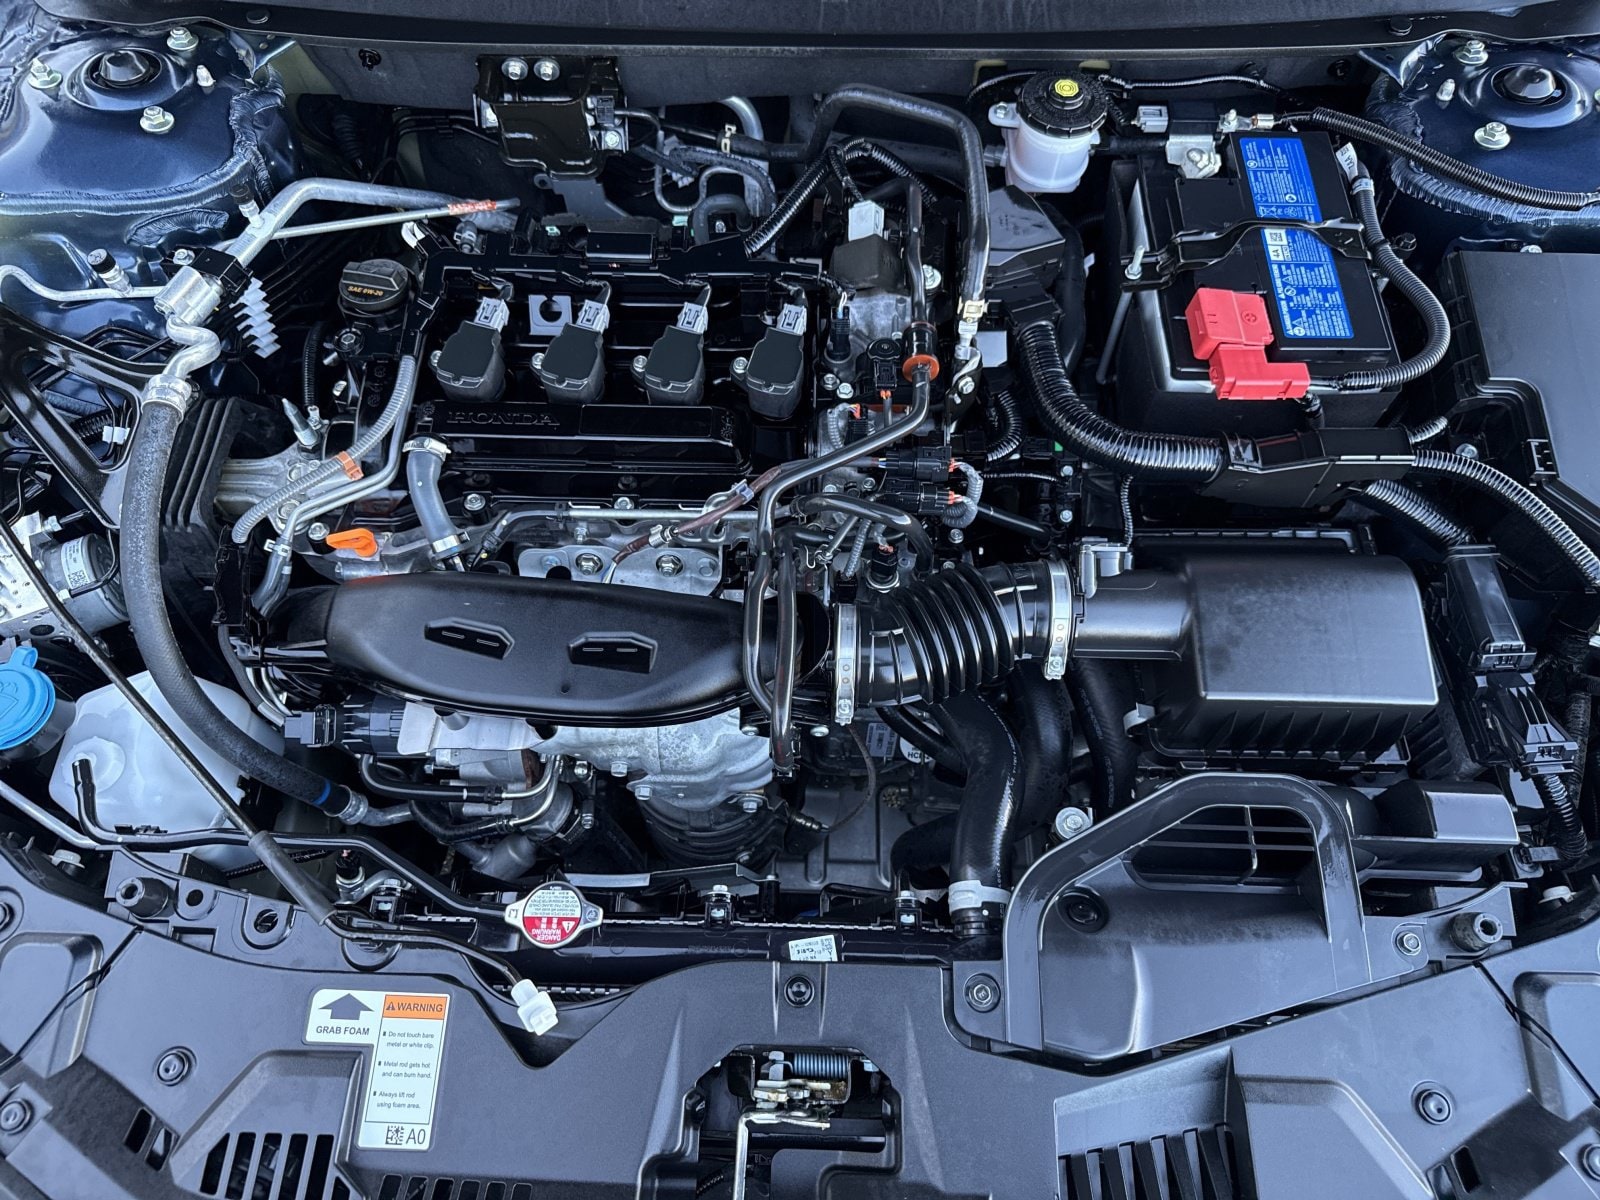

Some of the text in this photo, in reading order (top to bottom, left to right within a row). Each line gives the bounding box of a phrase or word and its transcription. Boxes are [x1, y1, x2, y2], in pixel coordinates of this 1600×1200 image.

[446, 412, 561, 426] HONDA
[397, 1002, 443, 1012] WARNING
[316, 1026, 370, 1035] GRAB FOAM
[377, 1101, 391, 1109] using
